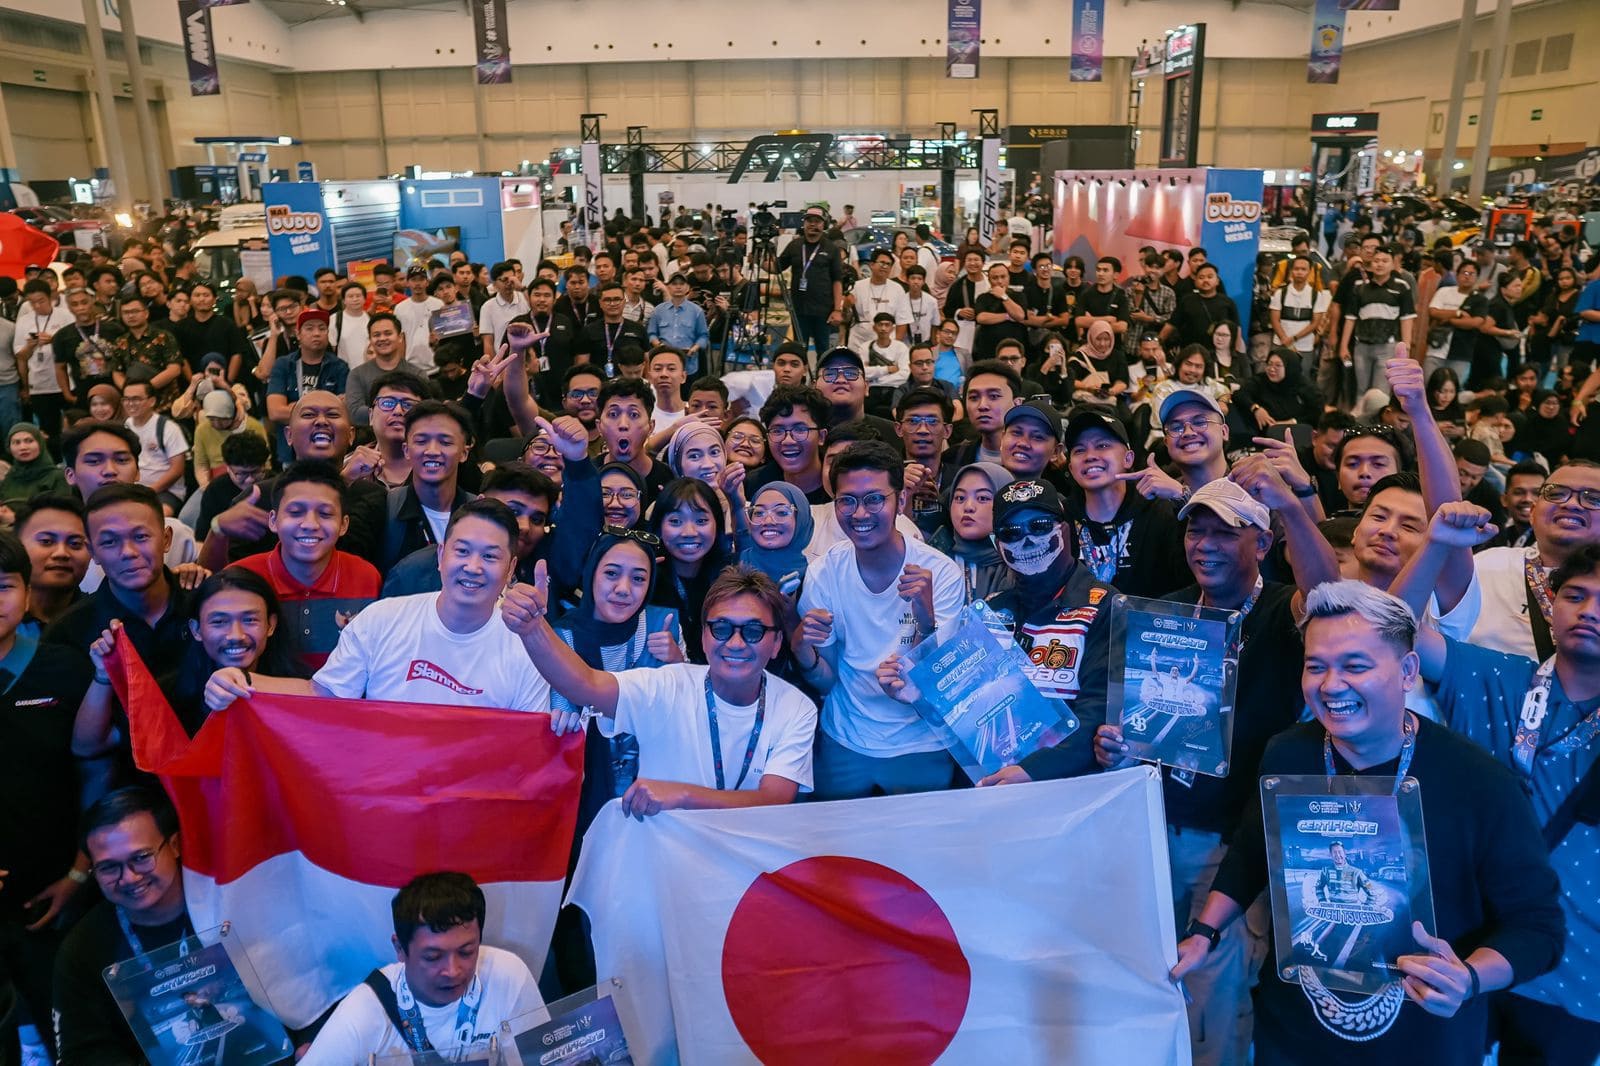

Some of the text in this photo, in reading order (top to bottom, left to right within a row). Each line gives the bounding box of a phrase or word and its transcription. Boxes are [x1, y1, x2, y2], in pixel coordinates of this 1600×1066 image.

[1209, 204, 1258, 218] DUDU
[271, 215, 319, 231] DUDU
[411, 662, 477, 695] Slammed
[1298, 820, 1378, 834] CERTIFICATE
